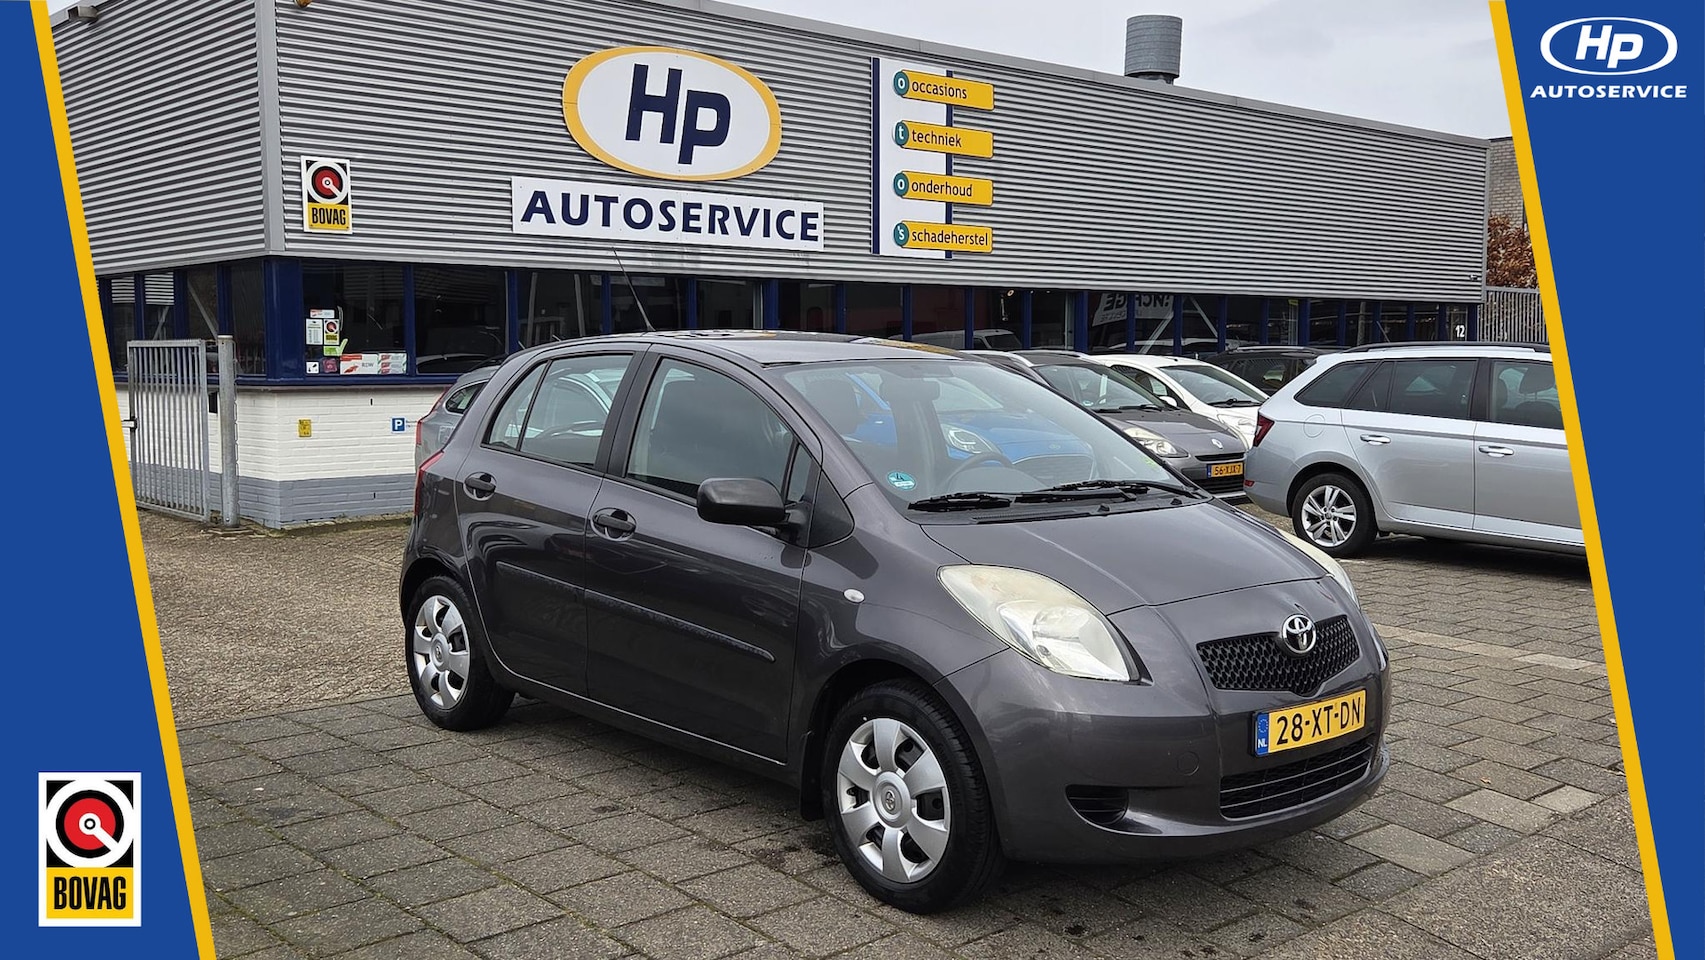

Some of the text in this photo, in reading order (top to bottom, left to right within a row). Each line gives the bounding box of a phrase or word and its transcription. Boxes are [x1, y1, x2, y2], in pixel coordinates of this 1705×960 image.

[911, 81, 967, 99] occasions
[625, 63, 731, 165] Hp
[911, 129, 962, 147] techniek
[911, 180, 973, 197] onderhoud
[311, 207, 346, 226] BOVAG
[520, 190, 819, 242] AUTOSERVICE
[911, 228, 988, 246] schadeherstel
[1455, 325, 1465, 338] 12
[394, 420, 403, 430] P
[1276, 697, 1361, 746] 28-XT-DN
[1257, 738, 1268, 748] NL
